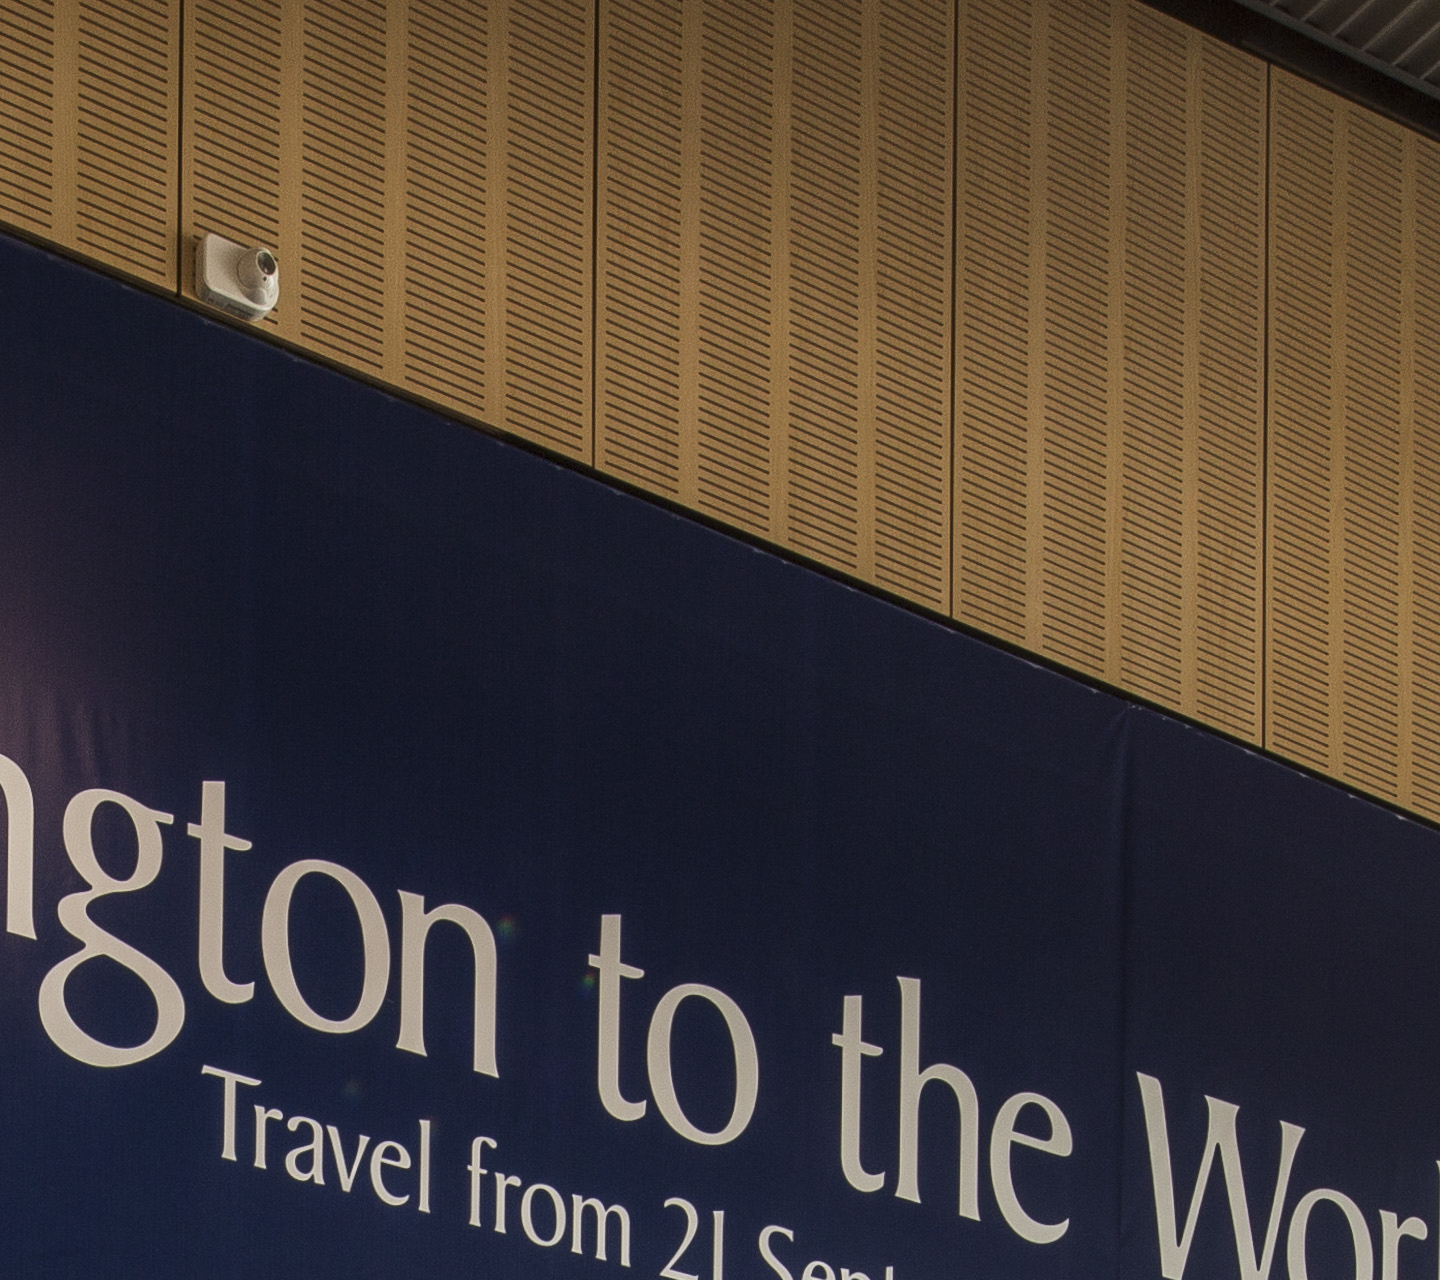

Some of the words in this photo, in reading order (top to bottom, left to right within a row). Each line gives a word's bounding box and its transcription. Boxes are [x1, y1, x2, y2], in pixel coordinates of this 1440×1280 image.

[202, 1064, 432, 1214] Travel
[468, 1138, 633, 1267] from
[589, 913, 760, 1146] to
[831, 976, 1075, 1244] the
